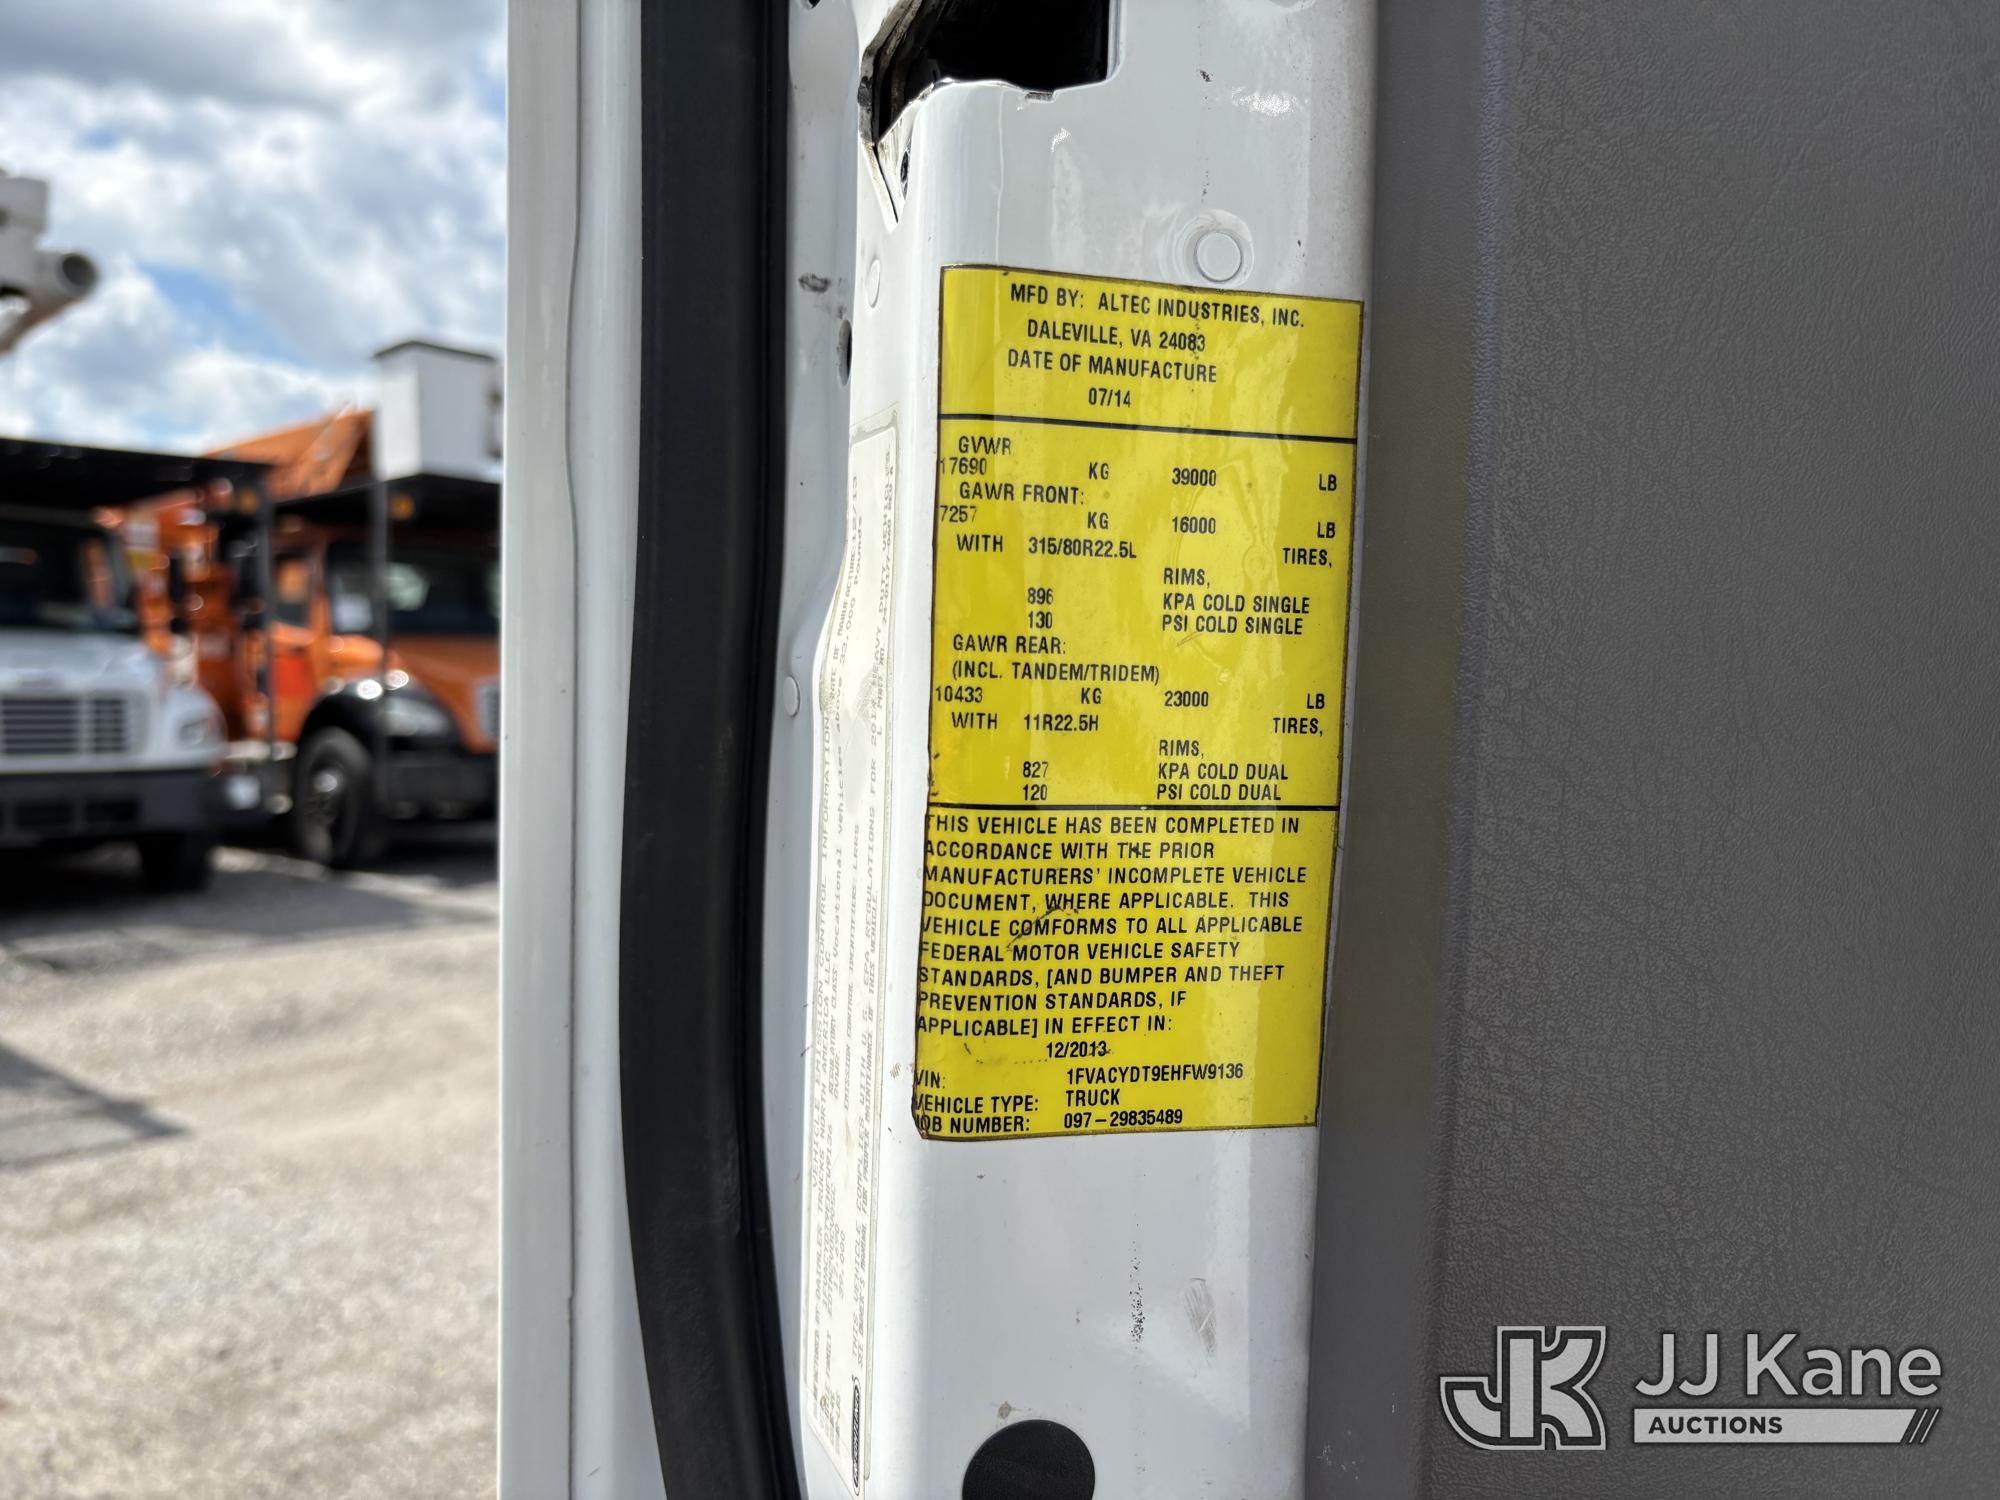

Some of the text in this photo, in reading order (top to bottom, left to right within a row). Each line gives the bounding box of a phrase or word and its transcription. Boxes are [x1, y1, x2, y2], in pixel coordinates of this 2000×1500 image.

[1011, 283, 1304, 327] MFD BY: ALTEC INDUSTRIES, INC.
[1028, 319, 1205, 354] DALEVILLE, VA 24083
[1008, 349, 1216, 382] DATE OF MANUFACTURE
[1089, 387, 1131, 408] 07/14
[959, 436, 1011, 455] GVWR
[1089, 462, 1109, 480] KG
[1172, 467, 1216, 487] 39000
[1319, 474, 1337, 491] LB
[960, 481, 1084, 504] GAWR FRONT:
[940, 505, 1335, 538] 7257 KG 16000 LB
[957, 534, 1332, 568] WITH 315/80R22.5L TIRES,
[1164, 568, 1210, 589] RIMS,
[1027, 587, 1310, 614] 896 KPA COLD SINGLE
[1028, 611, 1303, 635] 130 PSI COLD SINGLE
[953, 634, 1065, 654] GAWR REAR:
[952, 660, 1159, 686] (INCL. TANDEM/TRIDEM)
[936, 685, 1325, 709] 10433 KG 23000 LB
[952, 712, 1322, 737] WITH 11R22.5H TIRES,
[1159, 740, 1204, 759] RIMS,
[1023, 761, 1288, 780] 827 KPA COLD DUAL
[1023, 783, 1281, 801] 120 PSI COLD DUAL
[977, 817, 1057, 834] VEHICLE
[1066, 817, 1102, 834] HAS
[1111, 817, 1156, 833] BEEN
[1166, 817, 1274, 833] COMPLETED
[1282, 817, 1299, 833] IN
[925, 840, 1214, 860] ACCORDANCE WITH THE PRIOR
[1108, 867, 1224, 884] INCOMPLETE
[1232, 867, 1306, 883] VEHICLE
[923, 891, 1288, 913] DOCUMENT, WHERE APPLICABLE. THIS
[1009, 918, 1117, 935] COMFORMS
[1126, 918, 1147, 934] TO
[1156, 917, 1187, 933] ALL
[1195, 915, 1302, 933] APPLICABLE
[1013, 944, 1079, 961] MOTOR
[1087, 943, 1163, 959] VEHICLE
[1171, 942, 1240, 958] SAFETY
[920, 965, 1284, 989] STANDARDS, [AND BUMPER AND THEFT
[919, 991, 1186, 1011] PREVENTION STANDARDS, IF
[916, 1015, 1172, 1038] APPLICABLE] IN EFFECT IN:
[1045, 1041, 1107, 1057] 12/2013
[1067, 1063, 1243, 1085] 1FVACYDT9EHFW9136
[991, 1095, 1038, 1113] TYPE:
[1066, 1088, 1120, 1107] TRUCK
[950, 1116, 1030, 1133] NUMBER:
